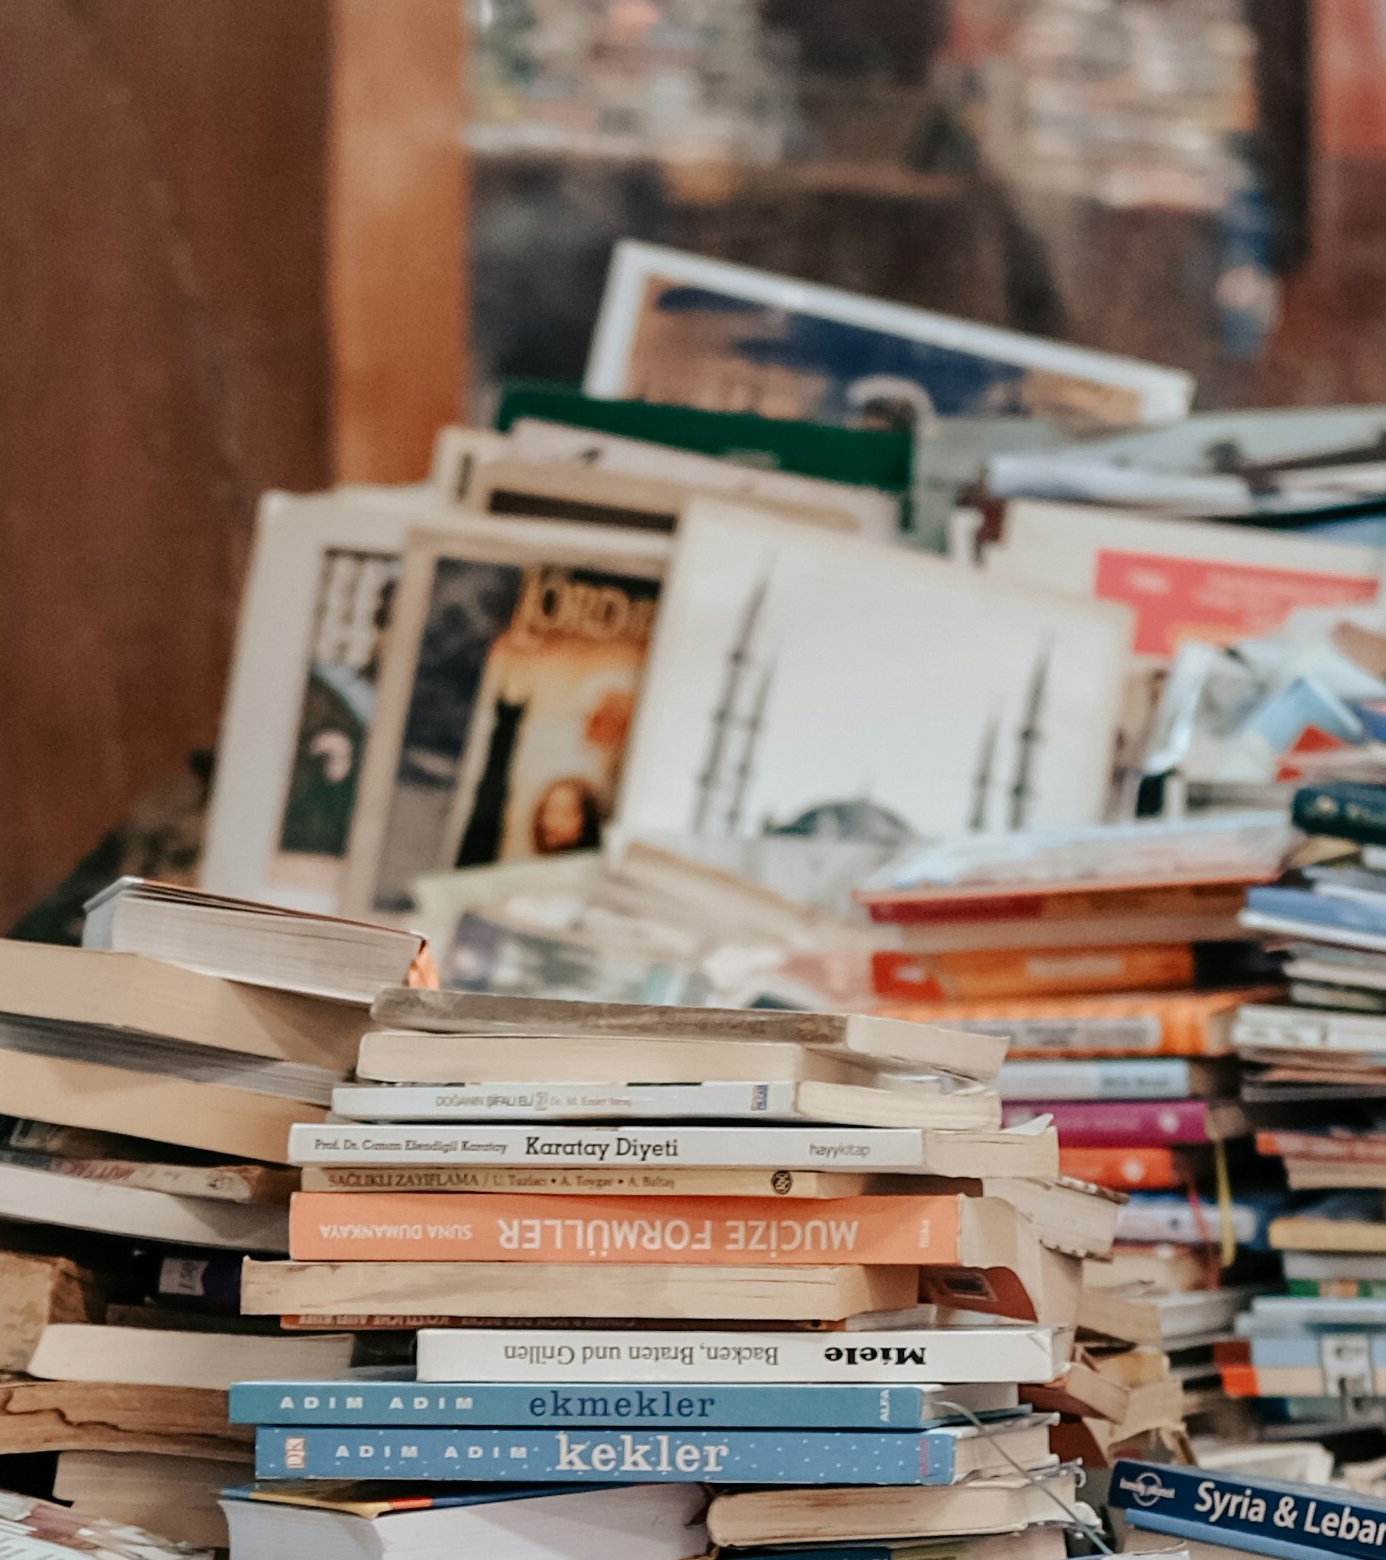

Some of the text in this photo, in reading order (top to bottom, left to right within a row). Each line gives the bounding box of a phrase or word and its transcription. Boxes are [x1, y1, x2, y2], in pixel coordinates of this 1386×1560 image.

[526, 1137, 678, 1161] Karatay Diyeti
[810, 1142, 870, 1158] hayykitap
[498, 1219, 859, 1258] MUCİZE FORMÜLLER
[504, 1343, 779, 1366] Backen, Braten und Grillen
[824, 1346, 927, 1366] Miele
[280, 1389, 715, 1419] ADIM ADIM ekmekler
[335, 1434, 730, 1473] ADIM ADIM kekler
[1194, 1481, 1266, 1523] Syria
[1273, 1497, 1298, 1528] &
